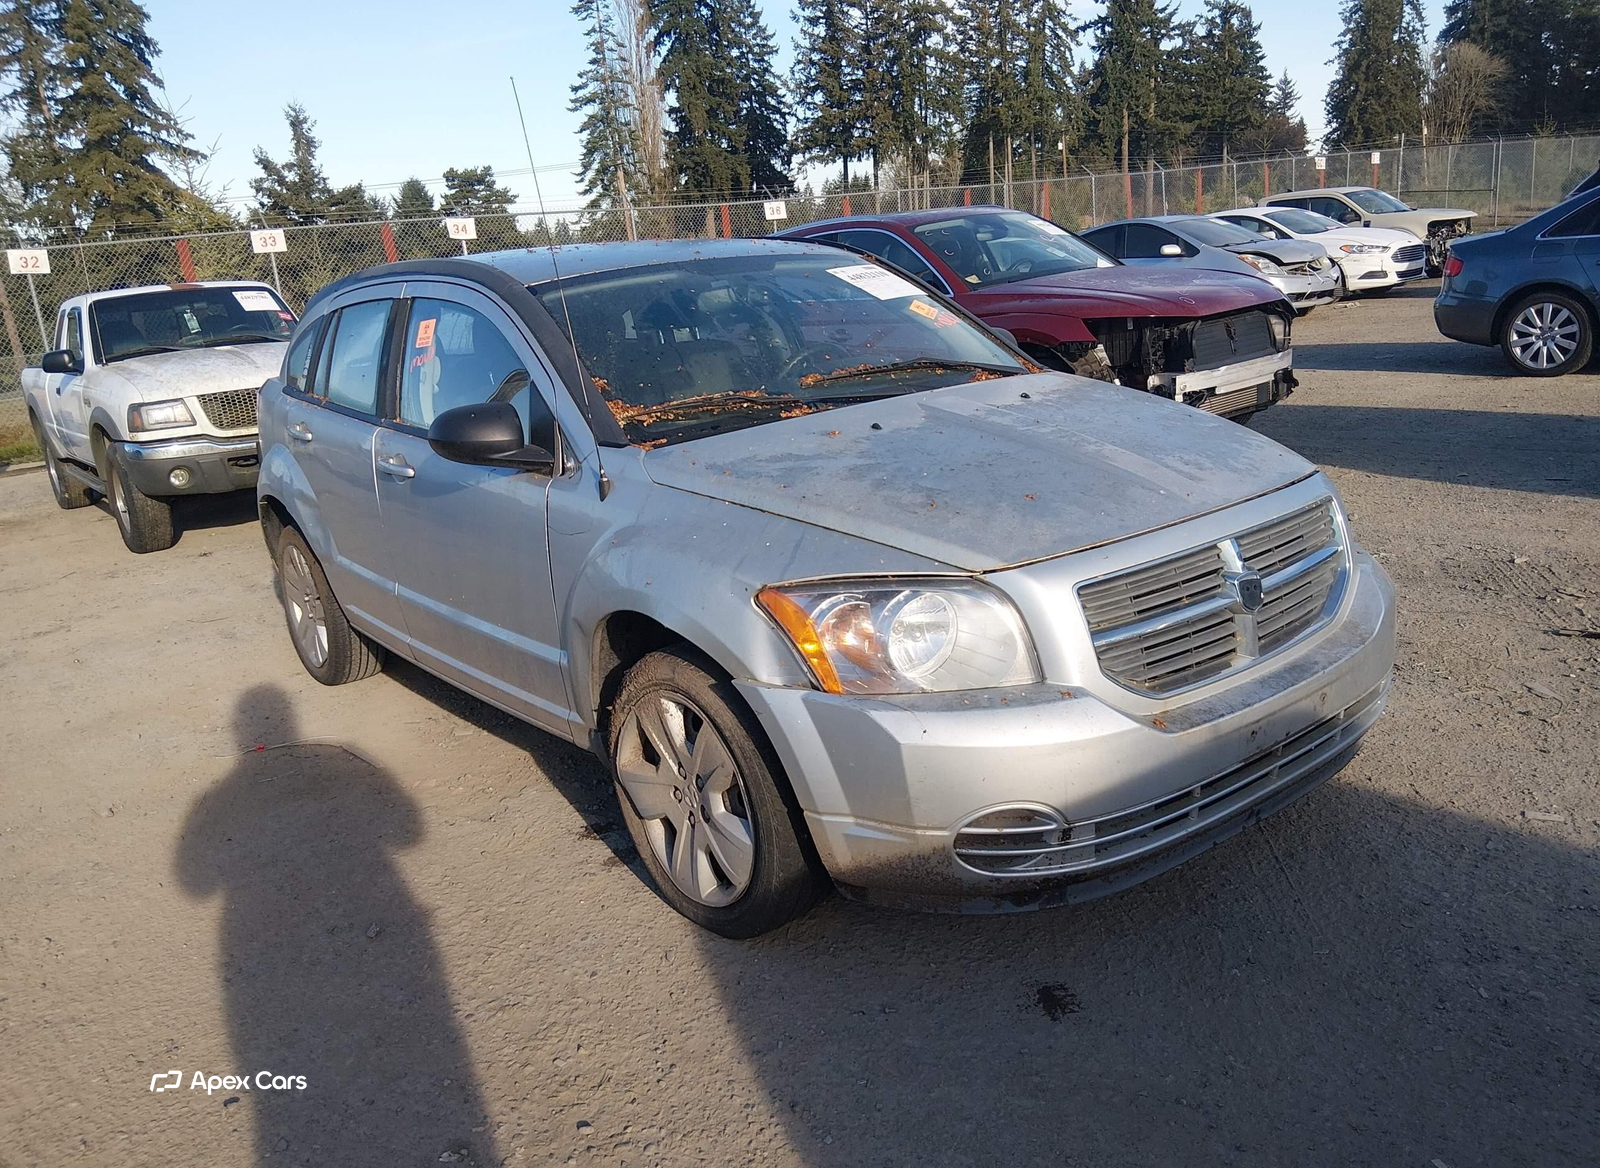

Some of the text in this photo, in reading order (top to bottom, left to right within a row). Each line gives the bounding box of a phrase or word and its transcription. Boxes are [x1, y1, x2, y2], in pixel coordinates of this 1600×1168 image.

[769, 206, 782, 216] 36
[452, 223, 468, 234] 34
[259, 235, 277, 248] 33
[19, 255, 40, 269] 32
